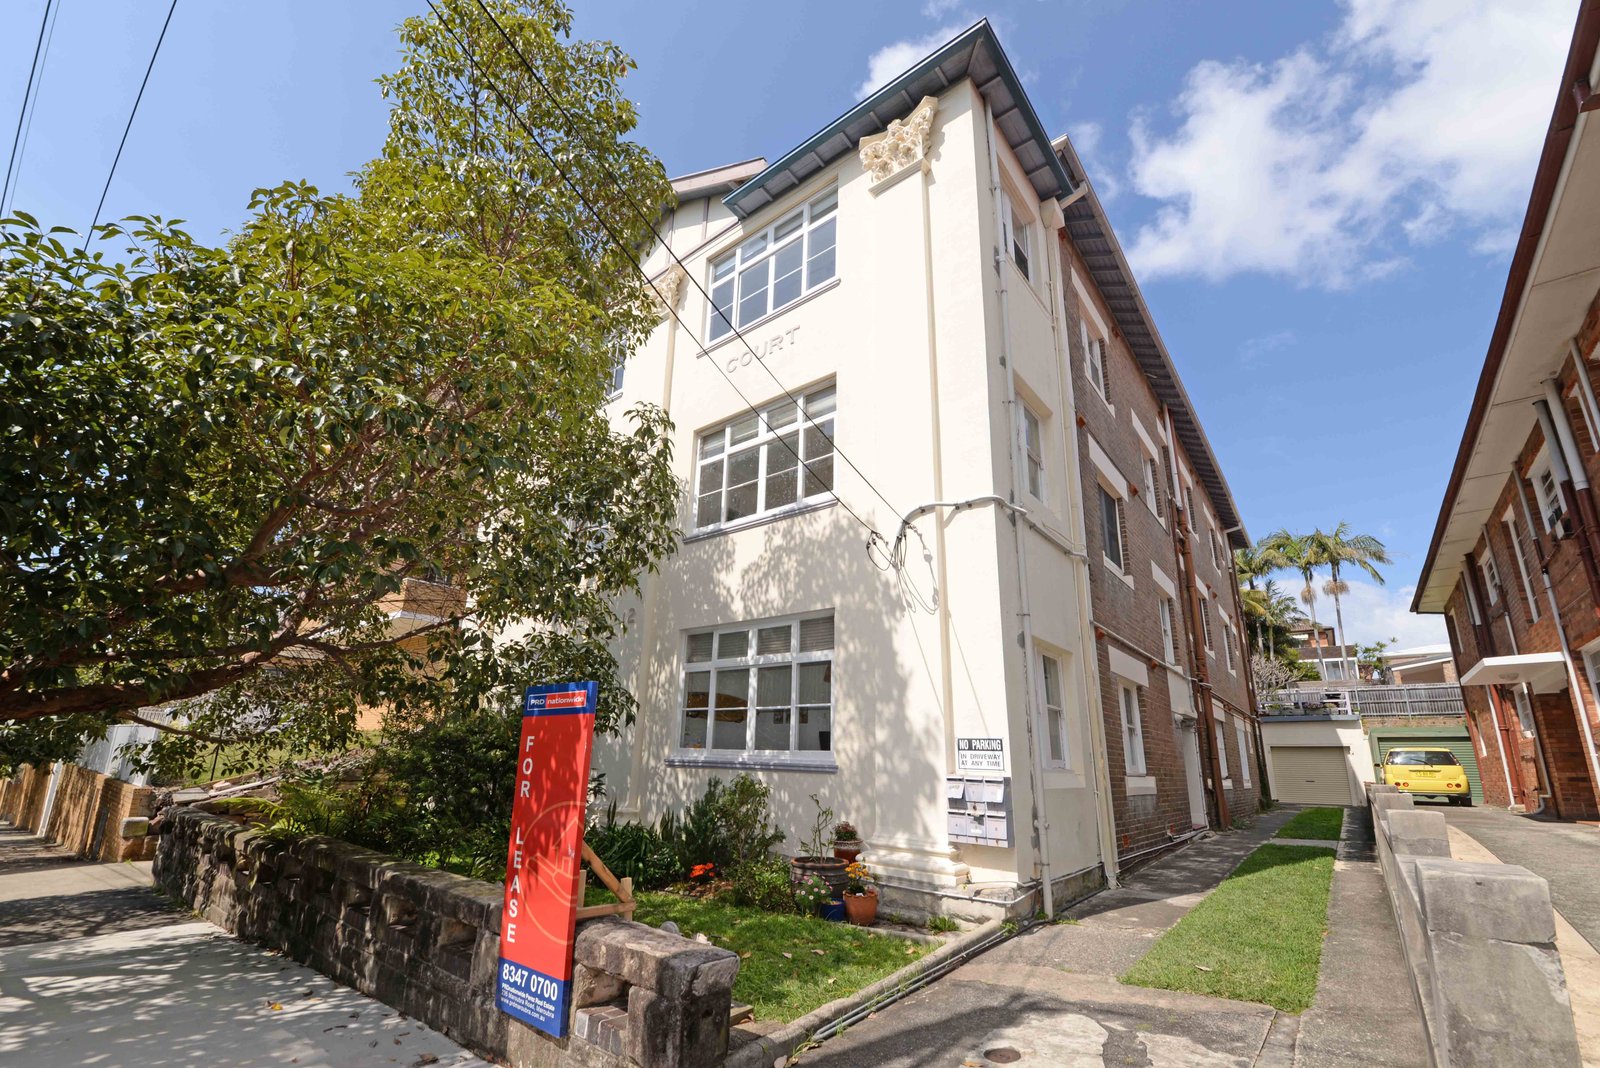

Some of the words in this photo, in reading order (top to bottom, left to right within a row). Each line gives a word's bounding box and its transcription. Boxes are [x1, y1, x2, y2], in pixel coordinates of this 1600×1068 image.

[726, 325, 800, 373] COURT
[530, 698, 545, 706] PRD
[547, 695, 585, 705] nationwide
[959, 739, 969, 750] NO
[972, 739, 1002, 750] PARKING
[520, 735, 535, 798] FOR
[506, 826, 524, 943] LEASE
[502, 963, 529, 988] 8347
[530, 974, 558, 1001] 0700
